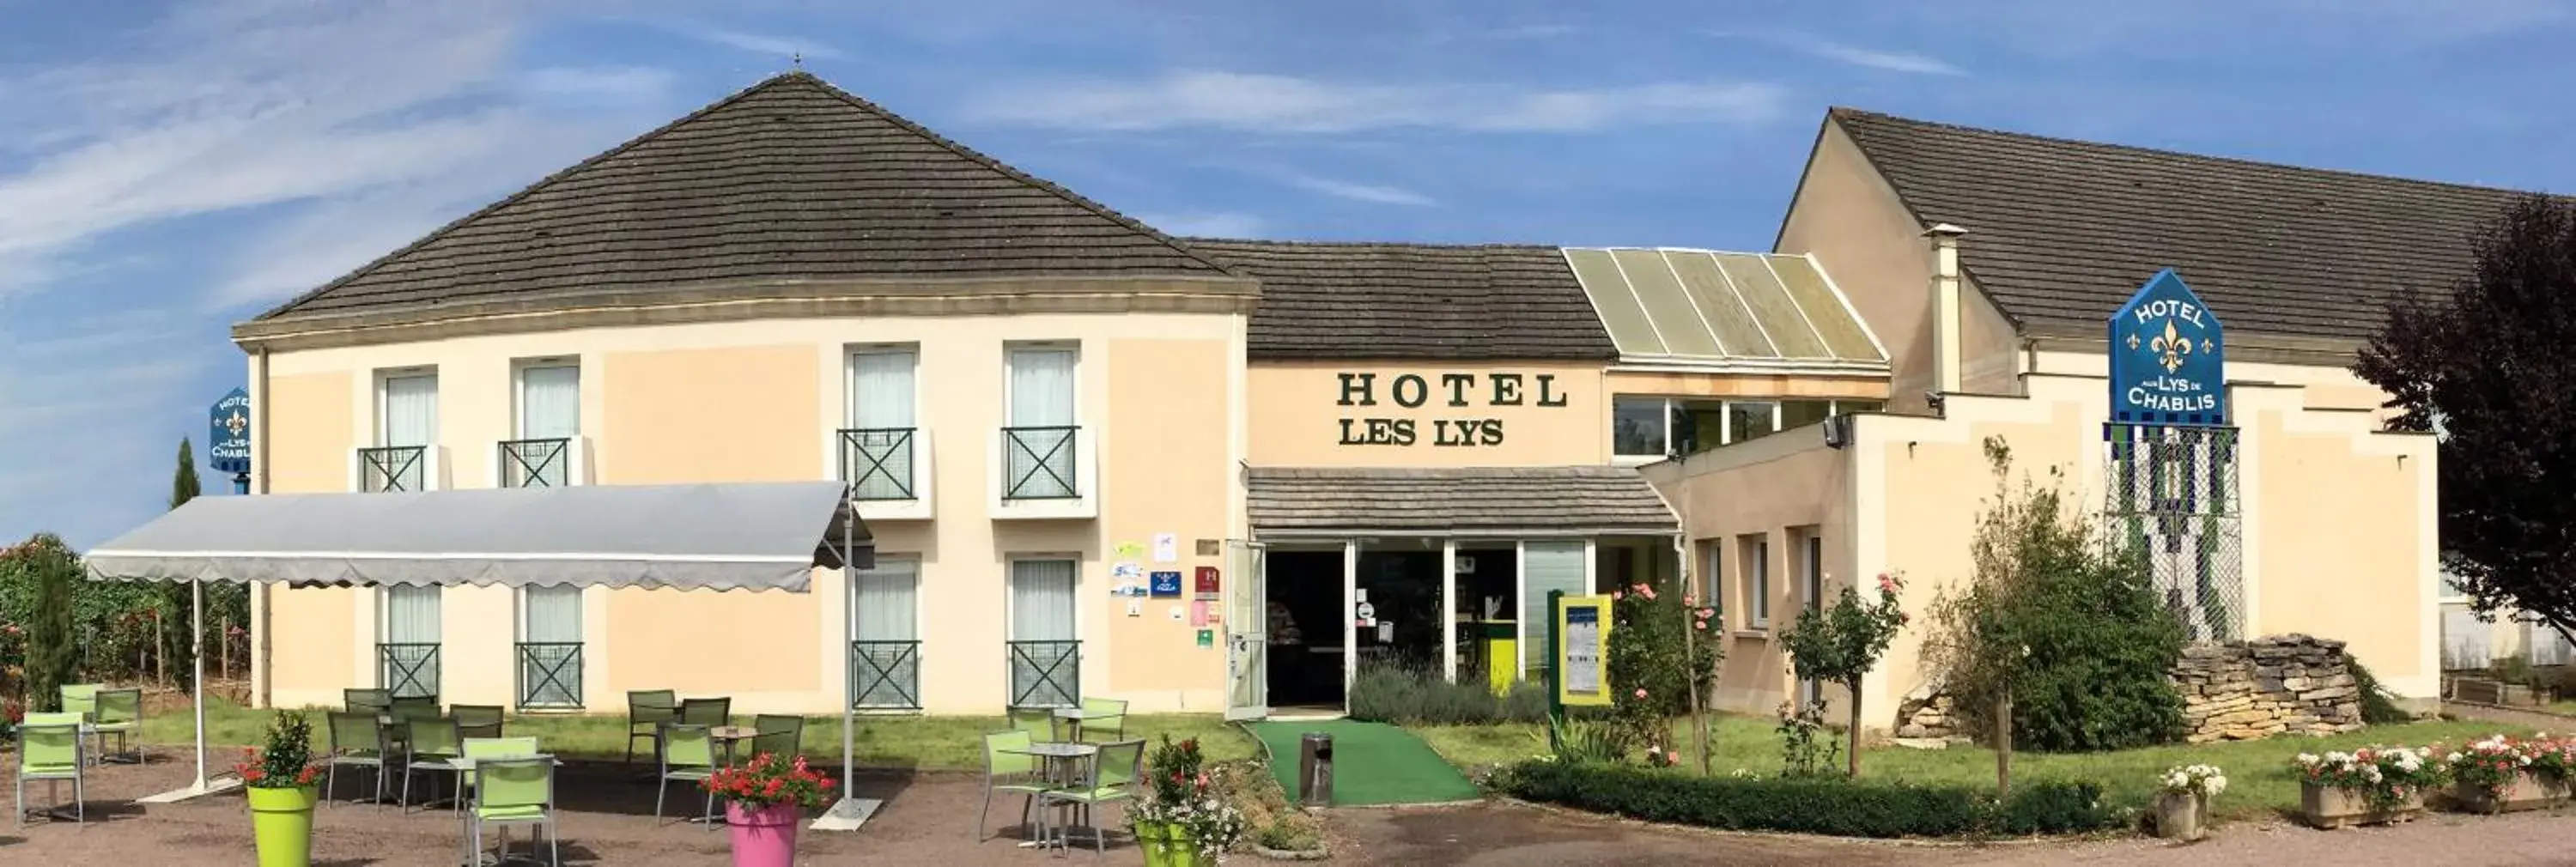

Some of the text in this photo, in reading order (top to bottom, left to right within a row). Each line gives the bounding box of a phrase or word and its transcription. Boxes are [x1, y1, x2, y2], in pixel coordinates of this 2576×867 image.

[2134, 300, 2207, 330] HOTEL
[1337, 373, 1567, 408] HOTEL
[2158, 375, 2189, 392] LYS
[2128, 387, 2215, 411] CHABLIS
[1339, 419, 1504, 446] LES LYS
[212, 446, 251, 458] CHABL
